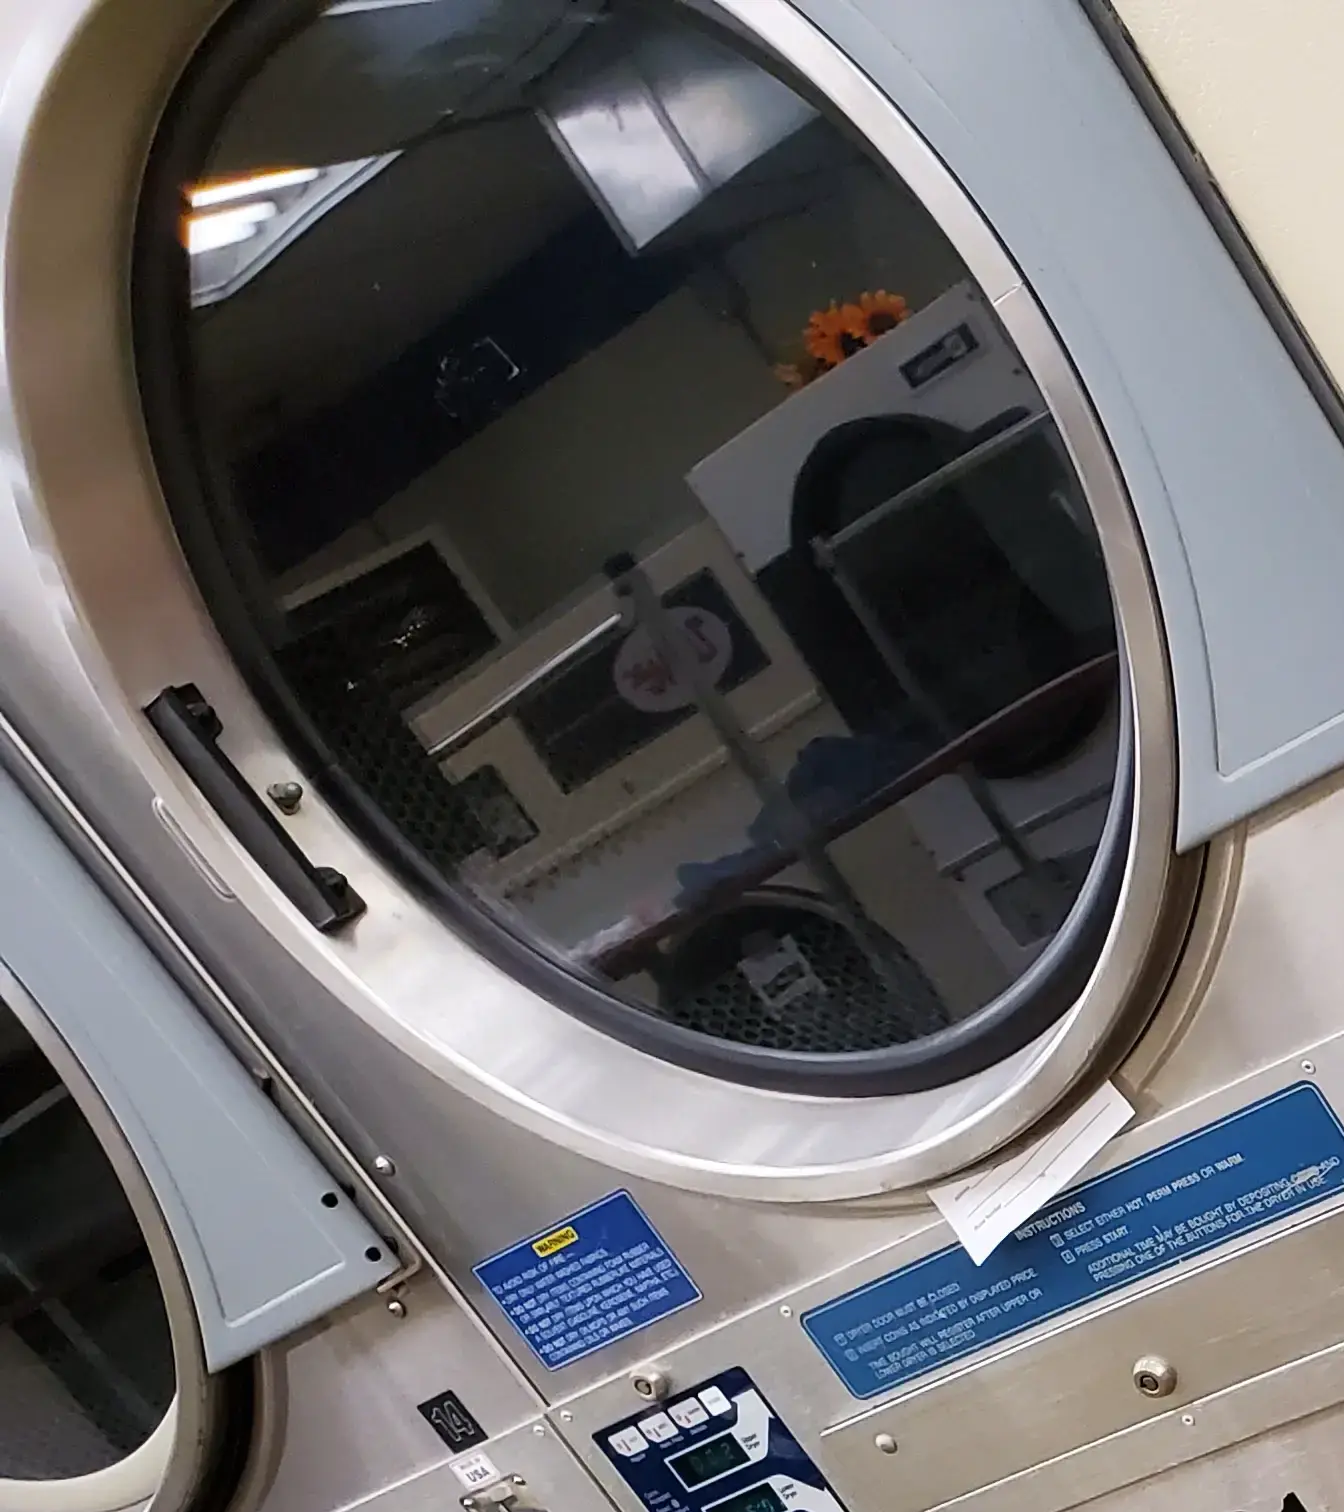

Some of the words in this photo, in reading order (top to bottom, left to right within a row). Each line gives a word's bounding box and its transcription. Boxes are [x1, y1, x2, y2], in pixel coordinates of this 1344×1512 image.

[1014, 1202, 1086, 1240] INSTRUCTIONS
[1063, 1219, 1096, 1240] SELECT
[1094, 1205, 1127, 1226] EITHER
[1145, 1185, 1172, 1202] PERM
[1170, 1172, 1201, 1191] PRESS
[1198, 1165, 1215, 1178] OR
[535, 1230, 575, 1254] WARNING
[1086, 1247, 1135, 1273] ADDITIONAL
[1135, 1237, 1156, 1252] TIME
[1173, 1223, 1188, 1235] BE
[1187, 1207, 1225, 1229] BOUGHT
[1224, 1201, 1239, 1212] BY
[1237, 1177, 1291, 1207] DEPOSITING
[1134, 1250, 1155, 1264] ONE
[1153, 1244, 1167, 1256] OF
[1167, 1236, 1186, 1250] THE
[1184, 1218, 1227, 1242] BUTTONS
[1225, 1209, 1246, 1224] FOR
[1245, 1202, 1263, 1215] THE
[1263, 1188, 1295, 1207] DRYER
[1294, 1182, 1307, 1194] IN
[1074, 1238, 1103, 1256] PRESS
[870, 1311, 896, 1328] DOOR
[882, 1326, 908, 1342] COINS
[906, 1320, 920, 1331] AS
[956, 1298, 970, 1309] BY
[968, 1279, 1012, 1304] DISPLAYED
[918, 1334, 938, 1348] WILL
[937, 1318, 976, 1340] REGISTER
[974, 1306, 1002, 1323] AFTER
[1000, 1294, 1028, 1312] UPPER
[1027, 1288, 1043, 1300] OR
[874, 1362, 902, 1379] LOWER
[900, 1350, 928, 1367] DRYER
[431, 1401, 475, 1442] 14
[465, 1466, 490, 1482] USA
